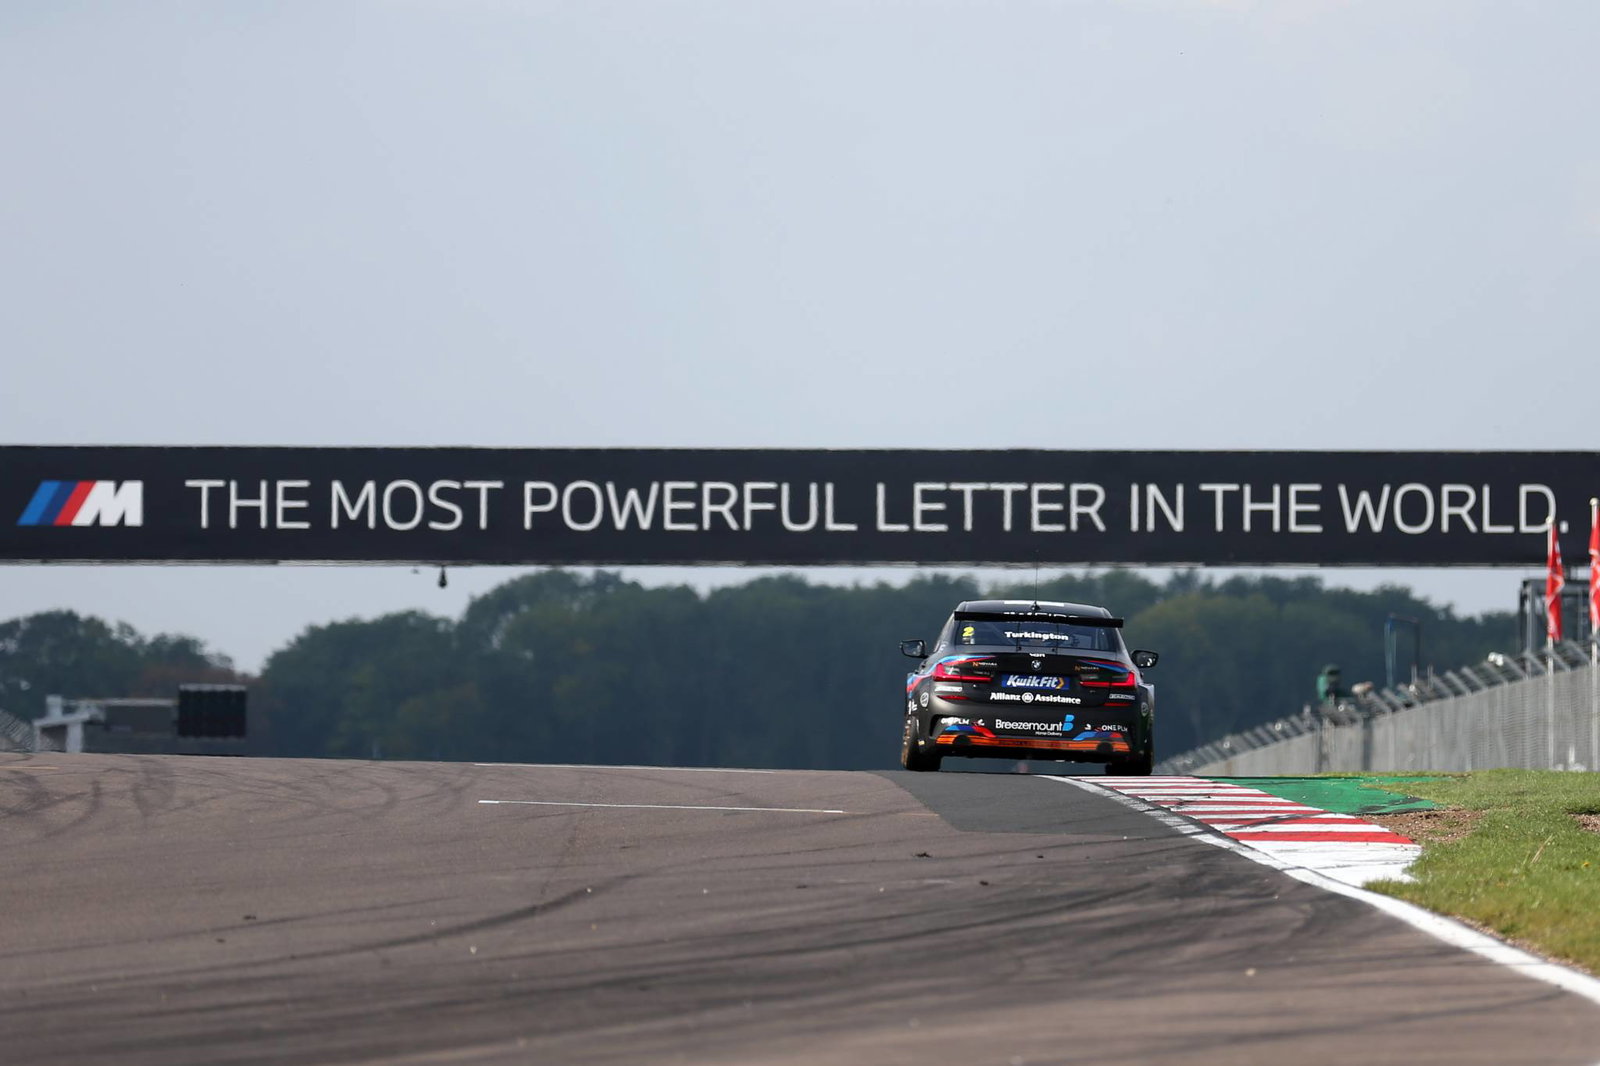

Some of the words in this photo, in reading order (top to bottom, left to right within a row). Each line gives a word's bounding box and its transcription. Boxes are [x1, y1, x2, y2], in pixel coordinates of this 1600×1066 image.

[185, 479, 310, 529] THE
[331, 479, 504, 531] MOST
[524, 481, 858, 532] POWERFUL
[876, 482, 1106, 532] LETTER
[1130, 483, 1184, 532] IN
[1199, 483, 1323, 533] THE
[1338, 484, 1569, 534] WORLD.
[962, 626, 975, 637] 2
[1004, 631, 1069, 642] Turkington
[989, 692, 1020, 701] Allianz
[1034, 694, 1081, 704] Assistance
[995, 719, 1063, 731] Breezemount
